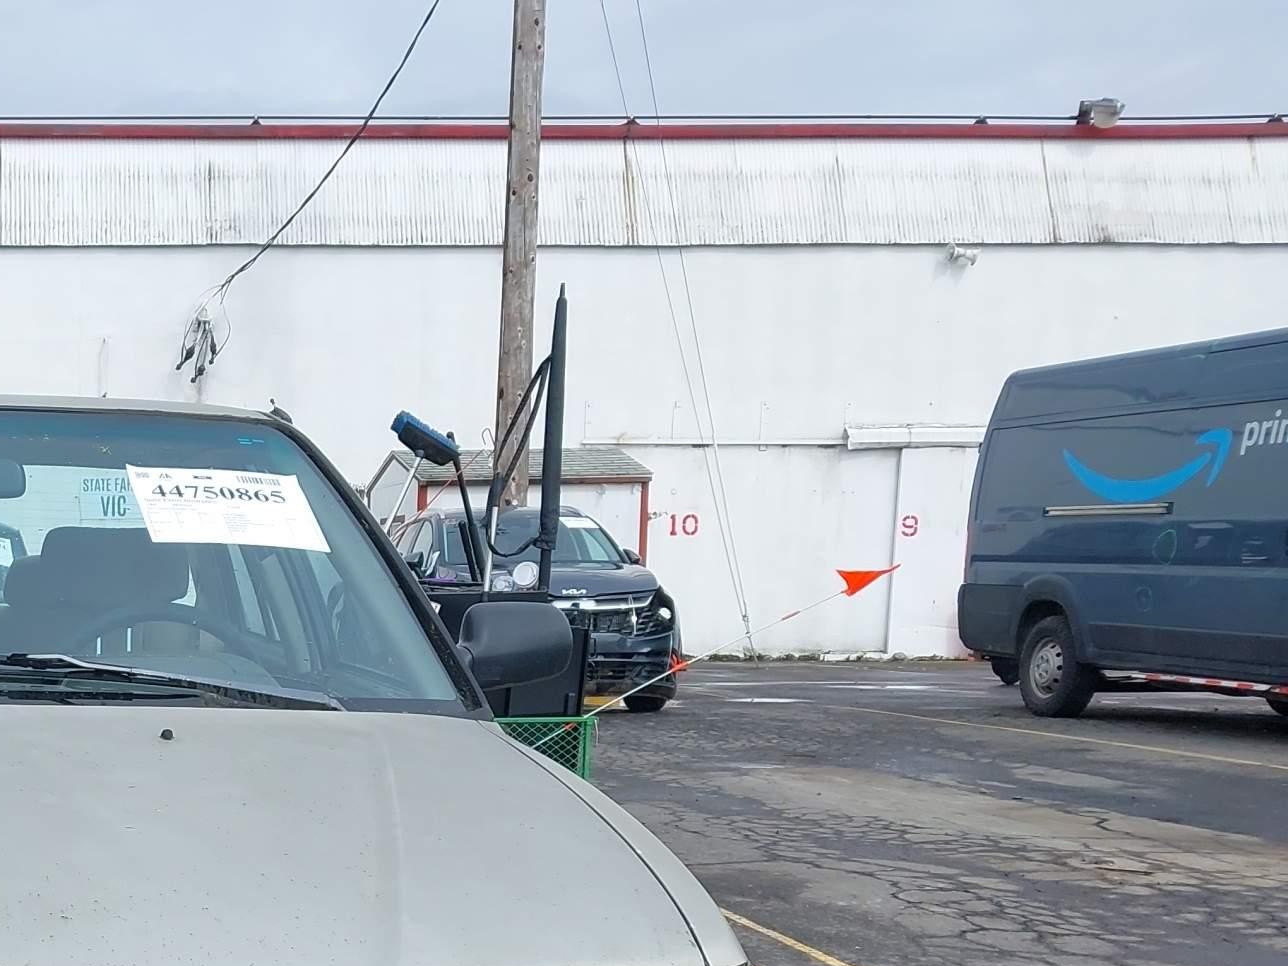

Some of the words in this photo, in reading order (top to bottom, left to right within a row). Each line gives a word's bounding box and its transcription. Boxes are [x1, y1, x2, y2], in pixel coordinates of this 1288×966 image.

[82, 478, 112, 492] STATE
[152, 484, 286, 504] 44750865
[101, 495, 127, 517] VIC
[669, 514, 698, 536] 10
[901, 515, 918, 537] 9
